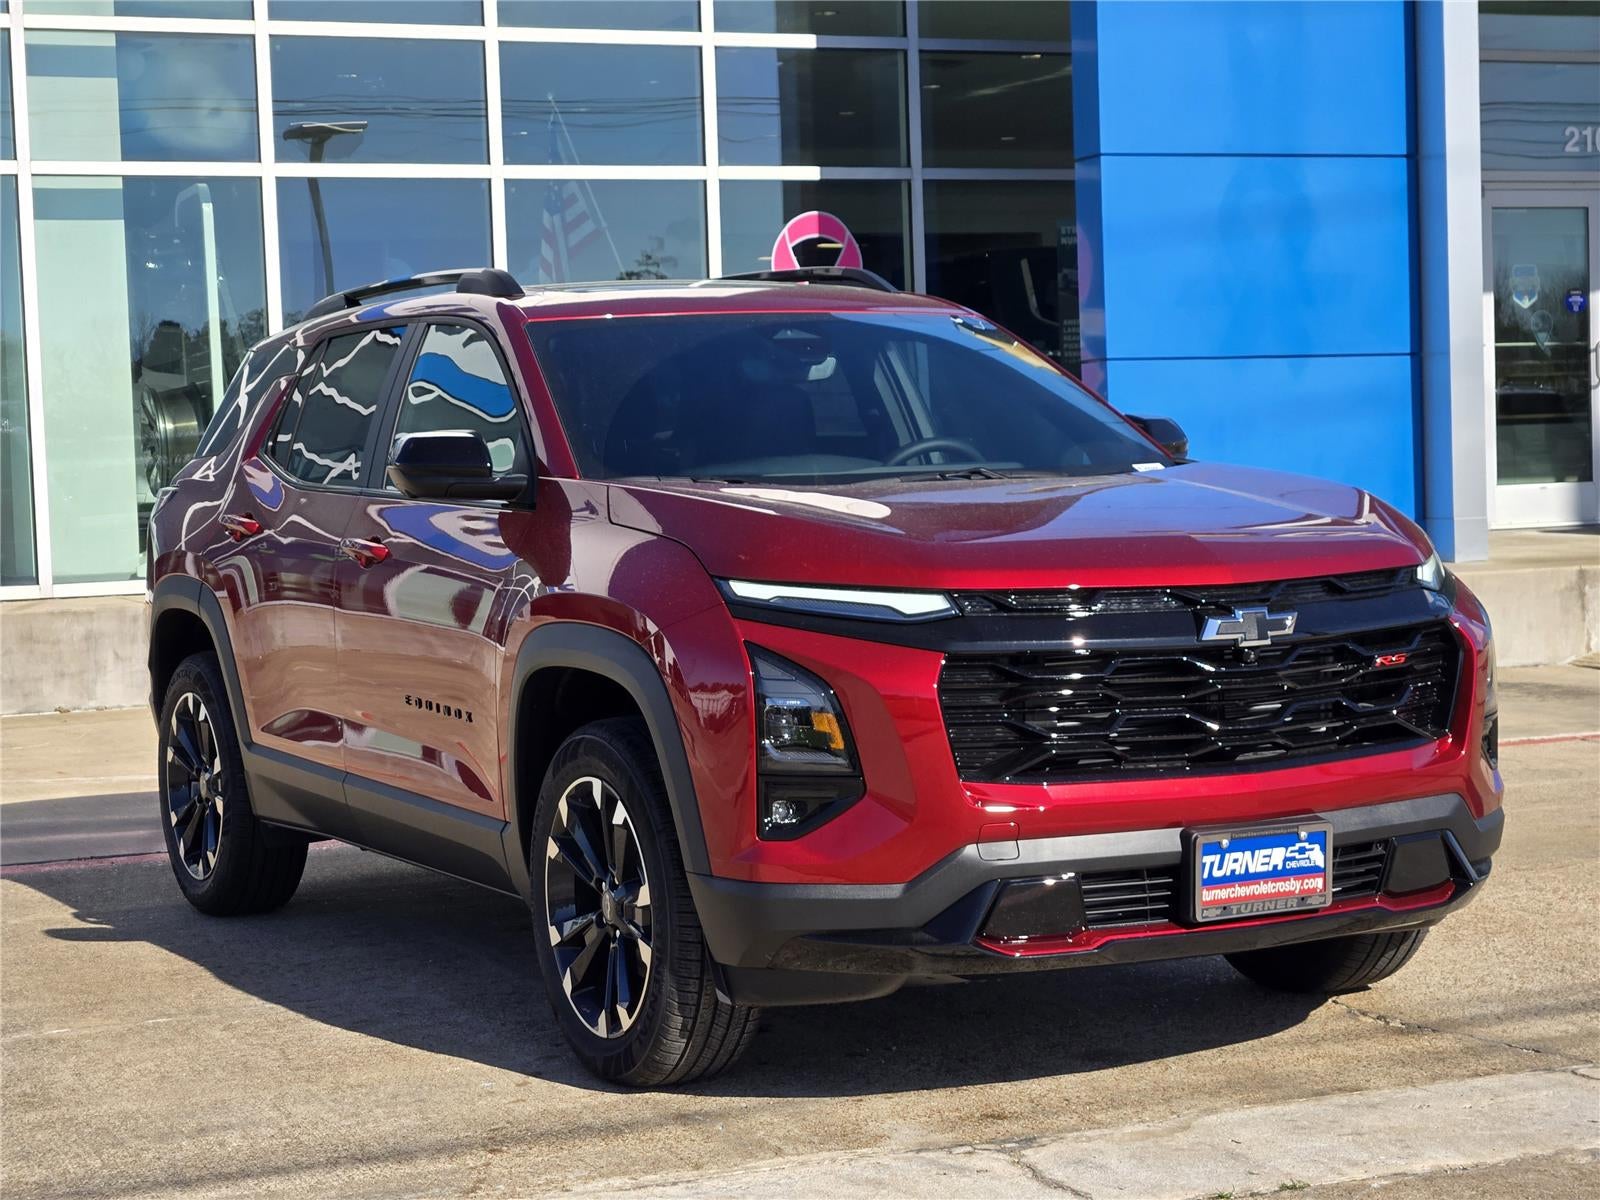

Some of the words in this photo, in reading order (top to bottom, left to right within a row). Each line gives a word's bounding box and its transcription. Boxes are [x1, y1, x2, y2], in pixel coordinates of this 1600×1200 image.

[1564, 126, 1600, 153] 21
[1375, 653, 1408, 667] RS
[404, 694, 473, 723] EQUINOX
[1202, 847, 1287, 879] TURNER
[1202, 877, 1323, 902] turnerchevroletcrosby.com
[1231, 898, 1297, 915] TURNER
